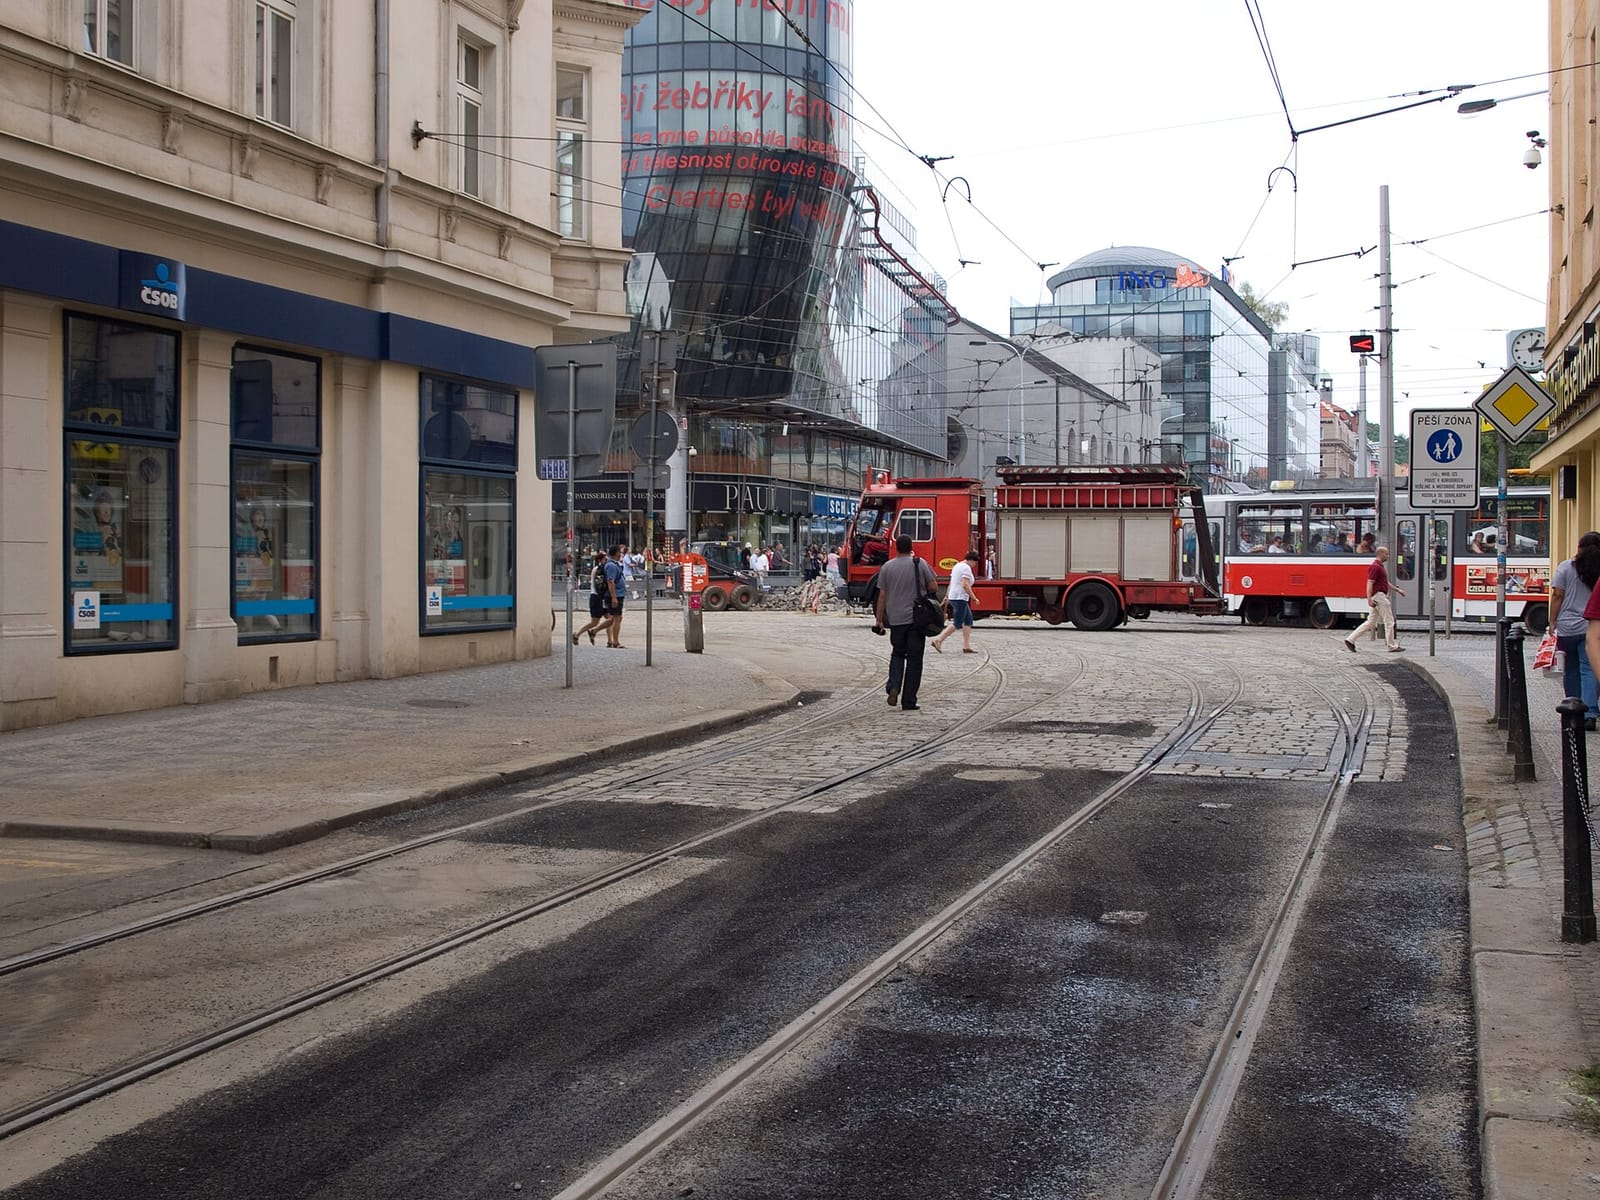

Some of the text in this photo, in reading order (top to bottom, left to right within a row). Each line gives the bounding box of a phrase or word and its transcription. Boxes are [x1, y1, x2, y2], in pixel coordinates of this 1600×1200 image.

[652, 80, 773, 118] žebříky
[657, 129, 699, 144] mne
[704, 125, 785, 148] působila
[737, 152, 816, 178] obrovské
[646, 183, 755, 211] Chartres
[761, 189, 797, 219] byl
[1118, 270, 1167, 291] ING
[140, 286, 178, 310] ČSOB
[1417, 414, 1473, 426] PĚŠÍ ZÓNA
[575, 491, 616, 500] PATISSERIES
[617, 491, 627, 500] ET
[724, 485, 777, 512] PAUL
